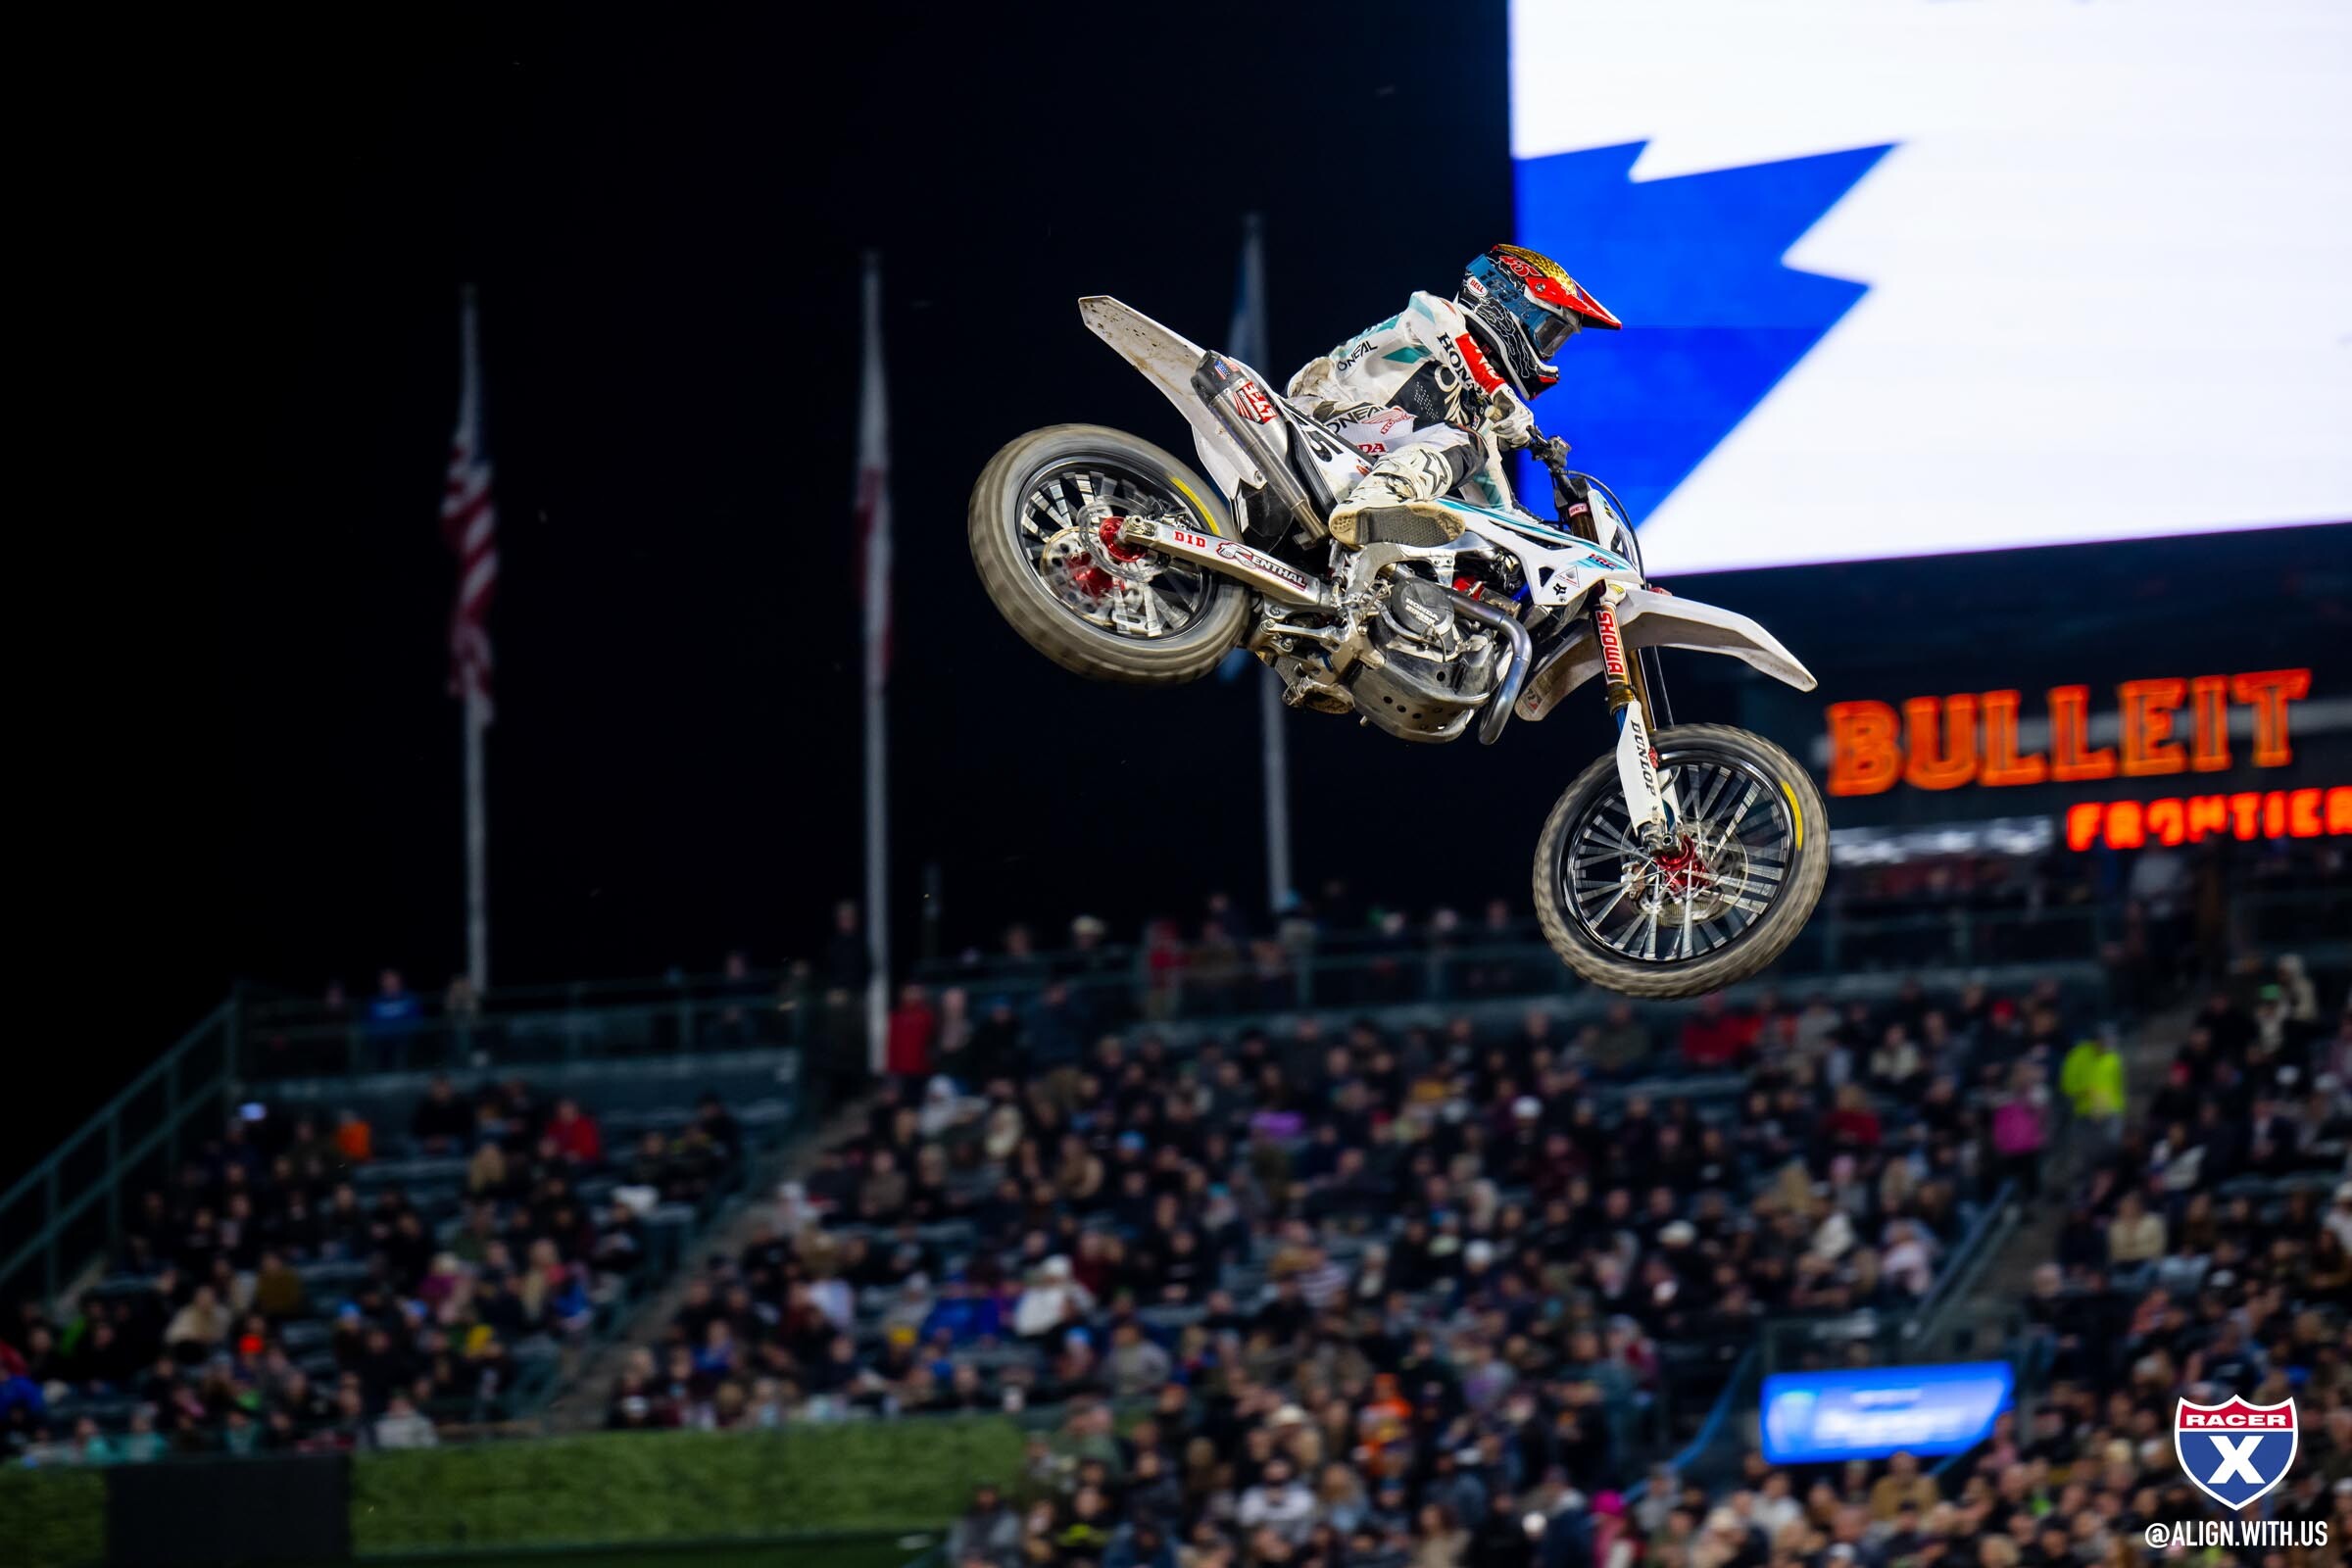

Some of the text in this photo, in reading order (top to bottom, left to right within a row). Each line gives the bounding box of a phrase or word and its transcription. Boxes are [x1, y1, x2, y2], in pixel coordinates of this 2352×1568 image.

[1469, 279, 1485, 294] BELL
[1337, 340, 1378, 371] ONEAL
[1437, 332, 1484, 394] HON
[1174, 530, 1206, 548] DID
[1216, 542, 1306, 590] RENTHAL
[1405, 597, 1440, 621] HONDA
[1596, 611, 1625, 676] SHOWA
[1827, 669, 2312, 796] BULLEIT
[1630, 719, 1656, 797] DUNLOP
